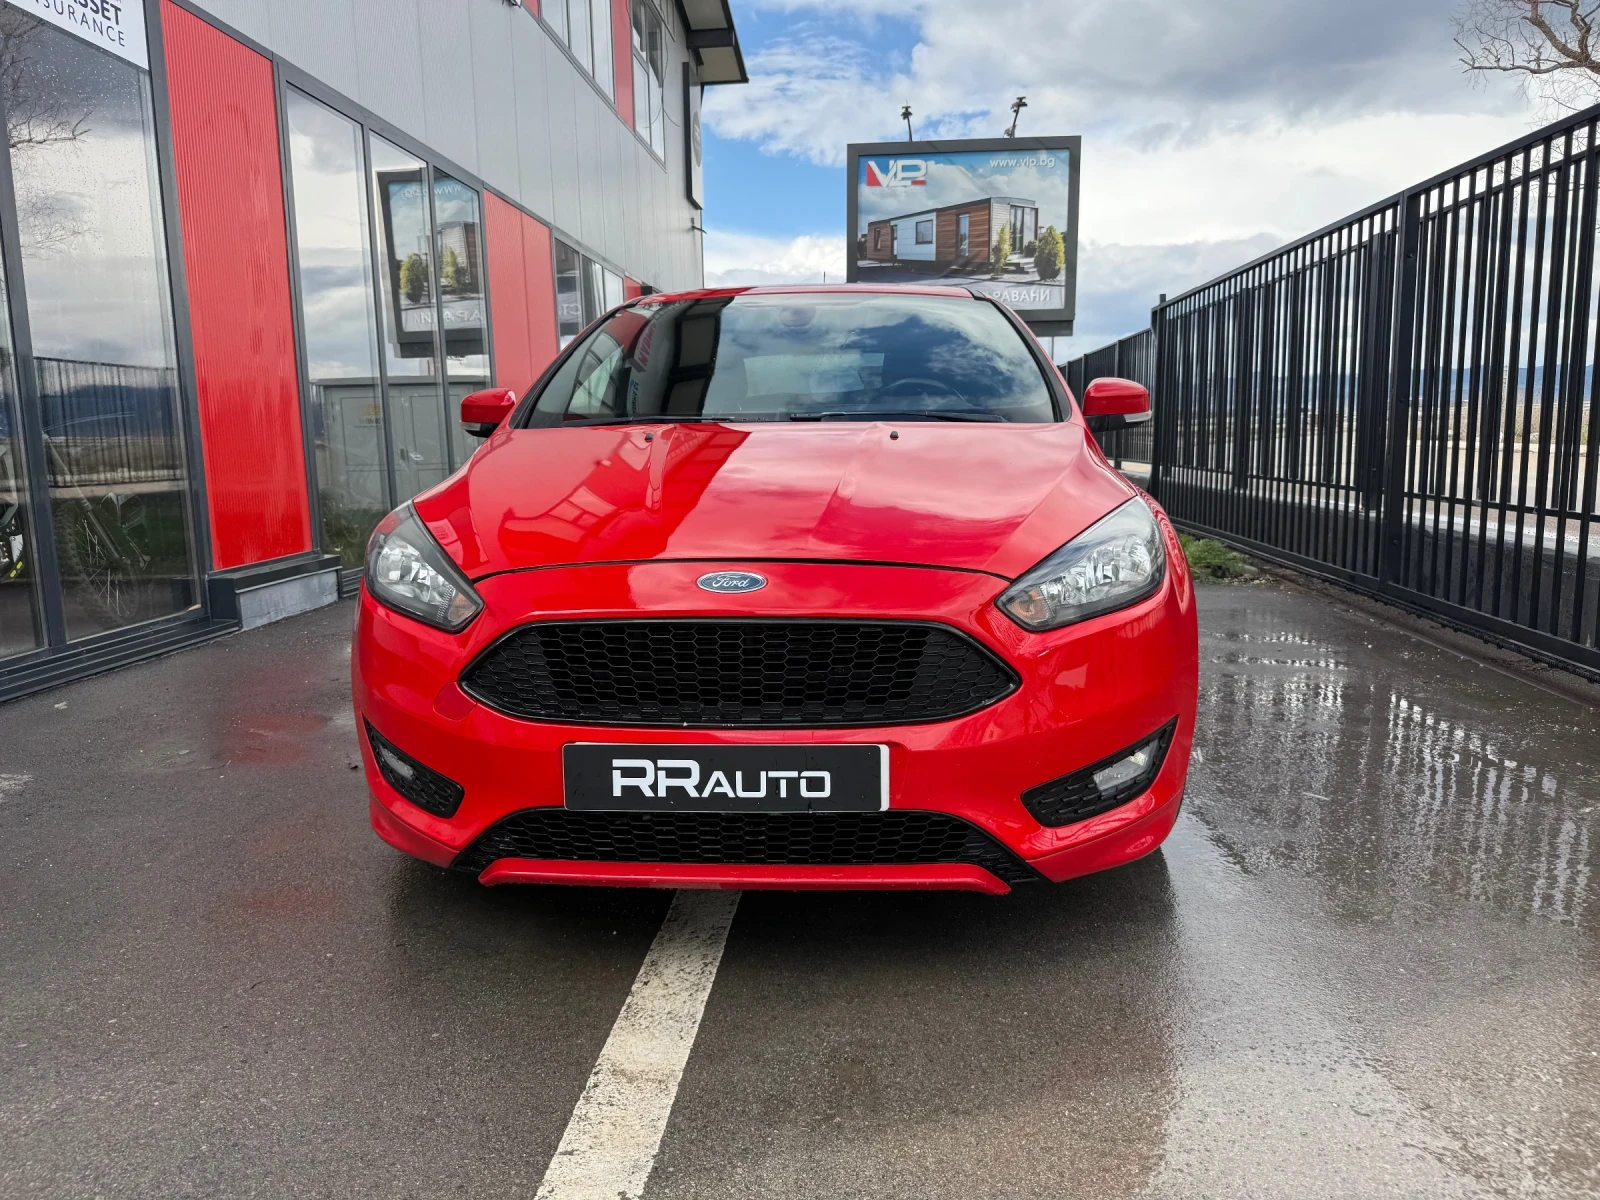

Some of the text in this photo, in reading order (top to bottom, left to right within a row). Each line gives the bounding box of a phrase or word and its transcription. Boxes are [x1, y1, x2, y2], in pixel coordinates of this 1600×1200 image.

[74, 0, 122, 25] SET
[36, 0, 125, 47] SURANCE
[989, 156, 1055, 168] www.vip.bg
[986, 288, 1050, 302] РАВАНИ
[712, 574, 750, 587] Ford
